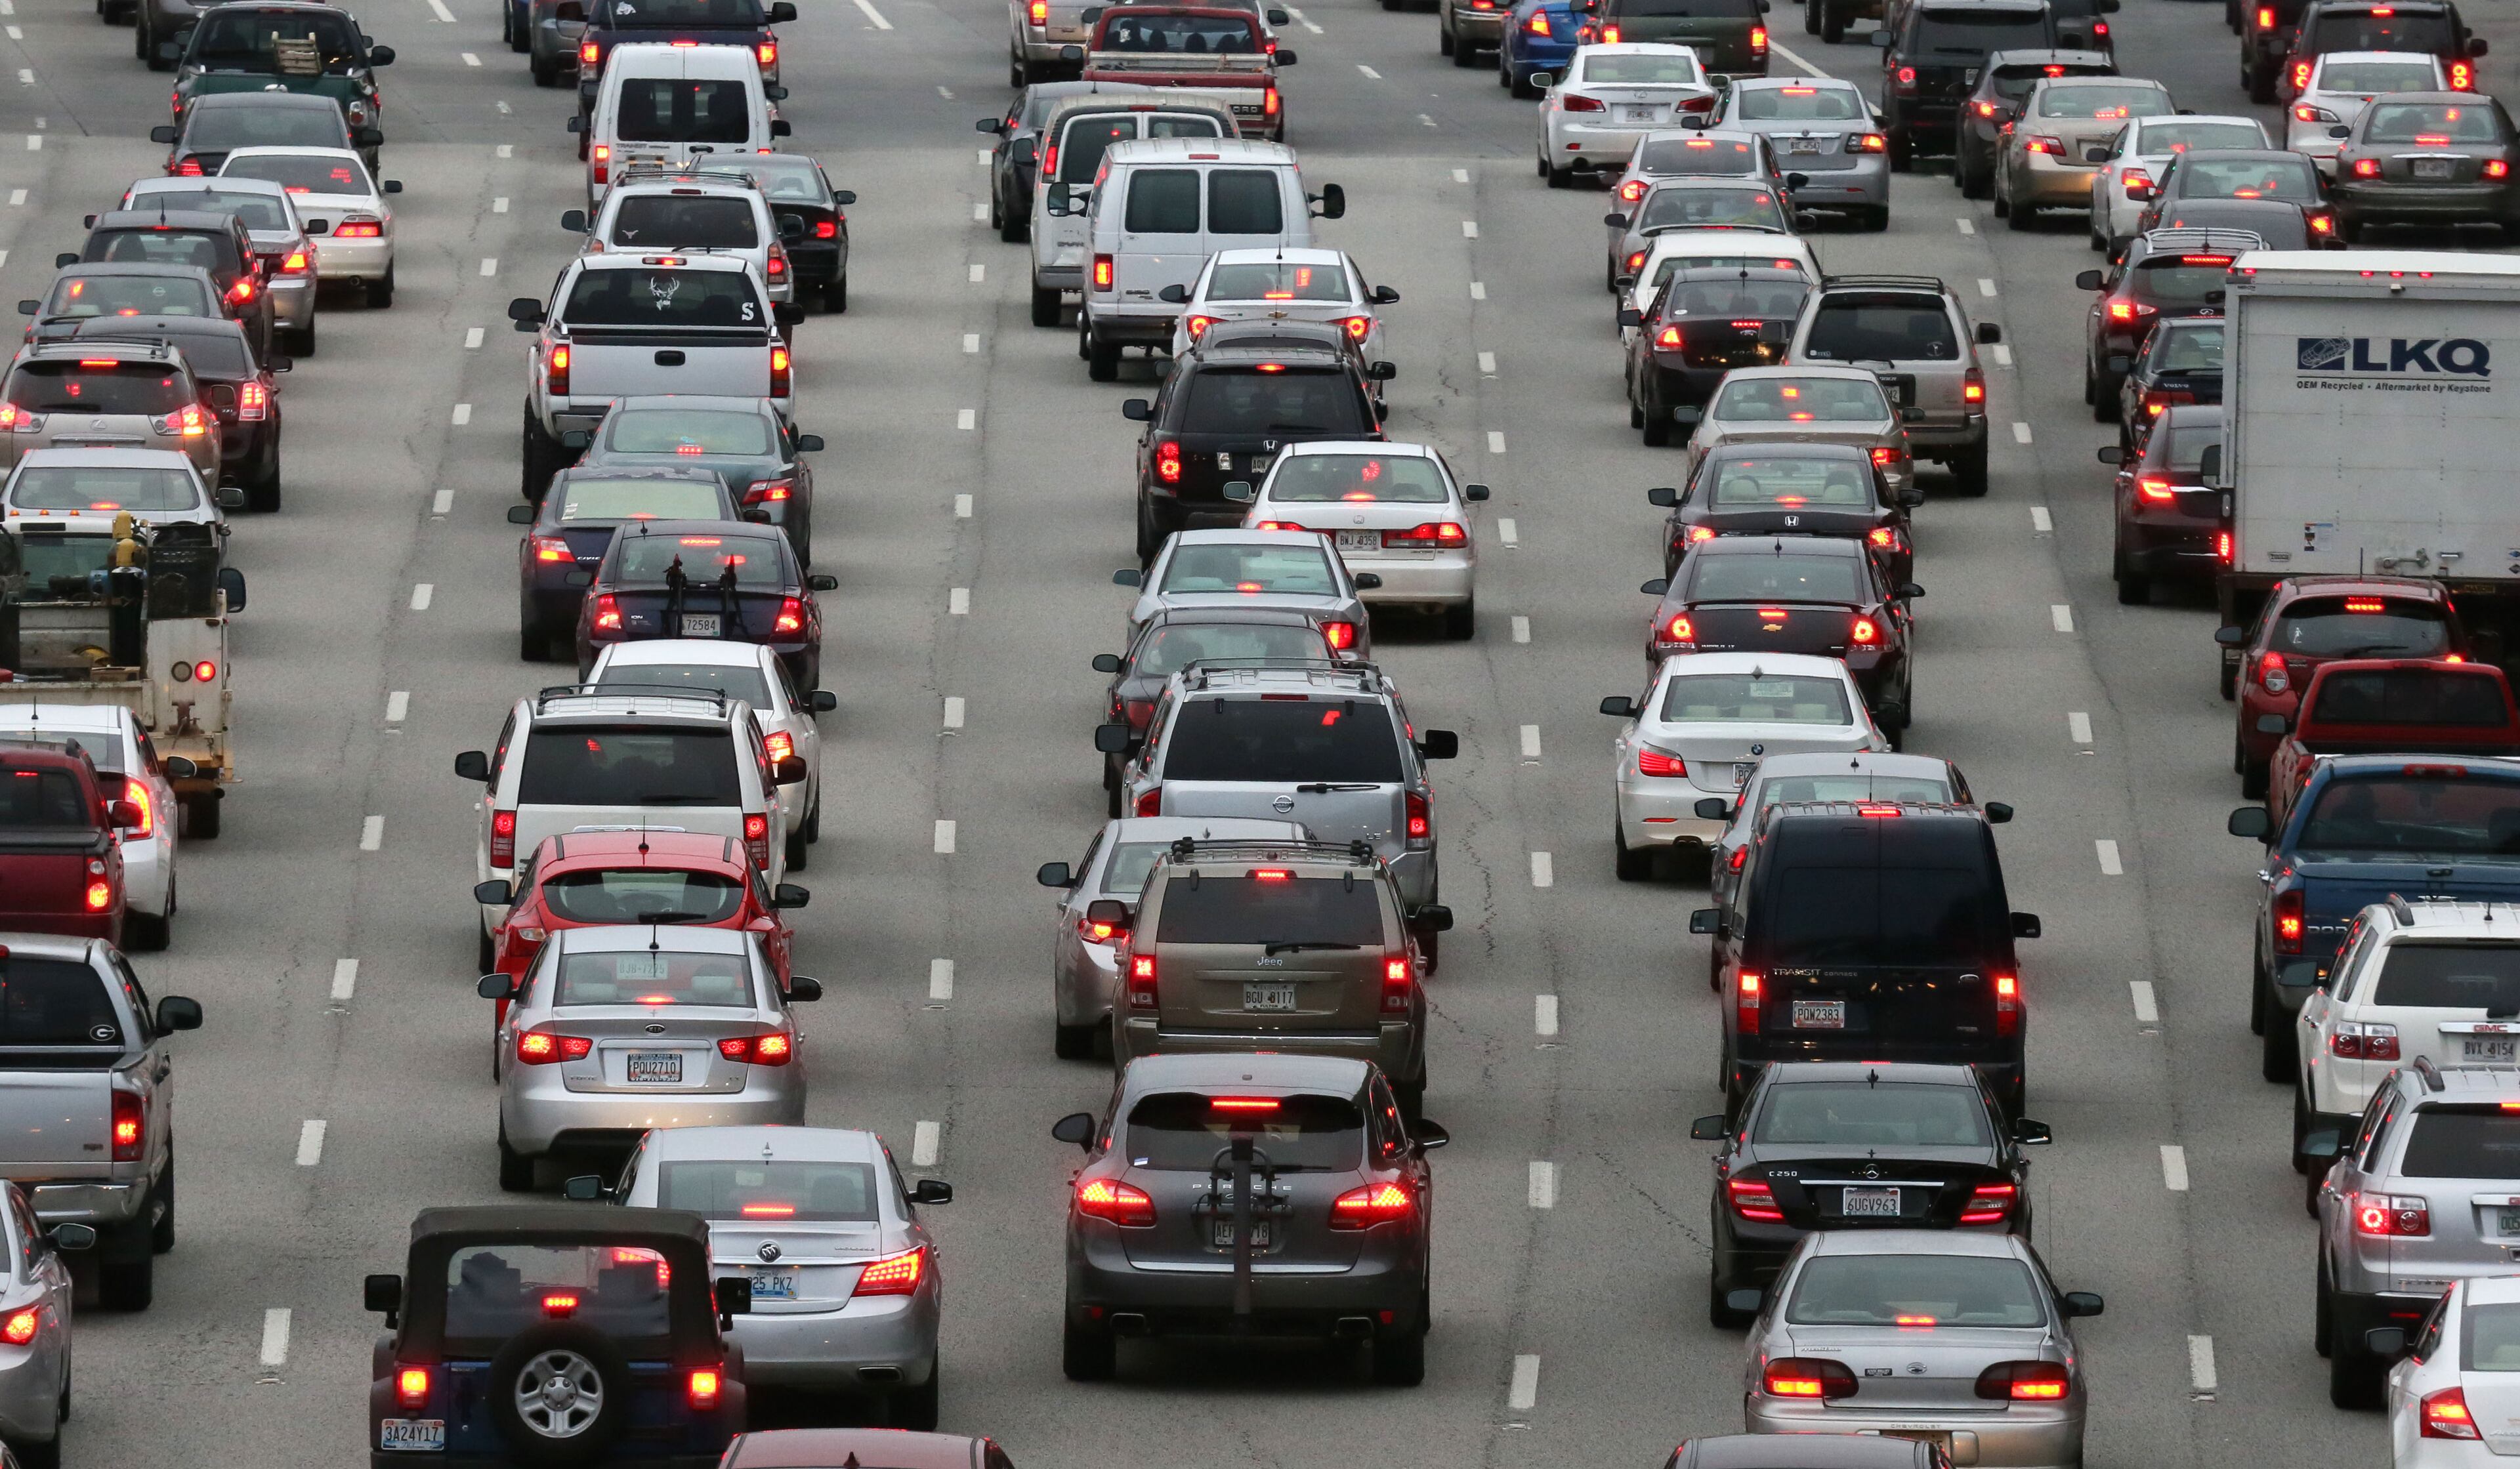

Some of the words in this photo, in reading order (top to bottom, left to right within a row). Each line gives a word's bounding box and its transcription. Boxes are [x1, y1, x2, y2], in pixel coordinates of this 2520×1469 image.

[742, 302, 754, 321] S
[2353, 338, 2492, 377] LKQ
[2297, 381, 2318, 390] OEM
[2321, 381, 2363, 392] Recycled
[2375, 383, 2431, 393] Aftermarket
[2433, 384, 2446, 394] by
[2448, 384, 2491, 394] Keystone
[687, 619, 716, 631] 72584
[2307, 925, 2347, 934] DOD
[1257, 957, 1283, 966] Jeep
[1246, 991, 1263, 1004] BGU
[1270, 991, 1293, 1004] 8117
[1798, 1008, 1839, 1022] PQW2383
[2473, 1024, 2508, 1033] GMC
[2465, 1042, 2482, 1055] BVX
[633, 1062, 677, 1075] PQU2710
[1847, 1198, 1897, 1211] 6UGV963
[773, 1277, 792, 1291] PKZ
[385, 1426, 439, 1441] 3A24Y17
